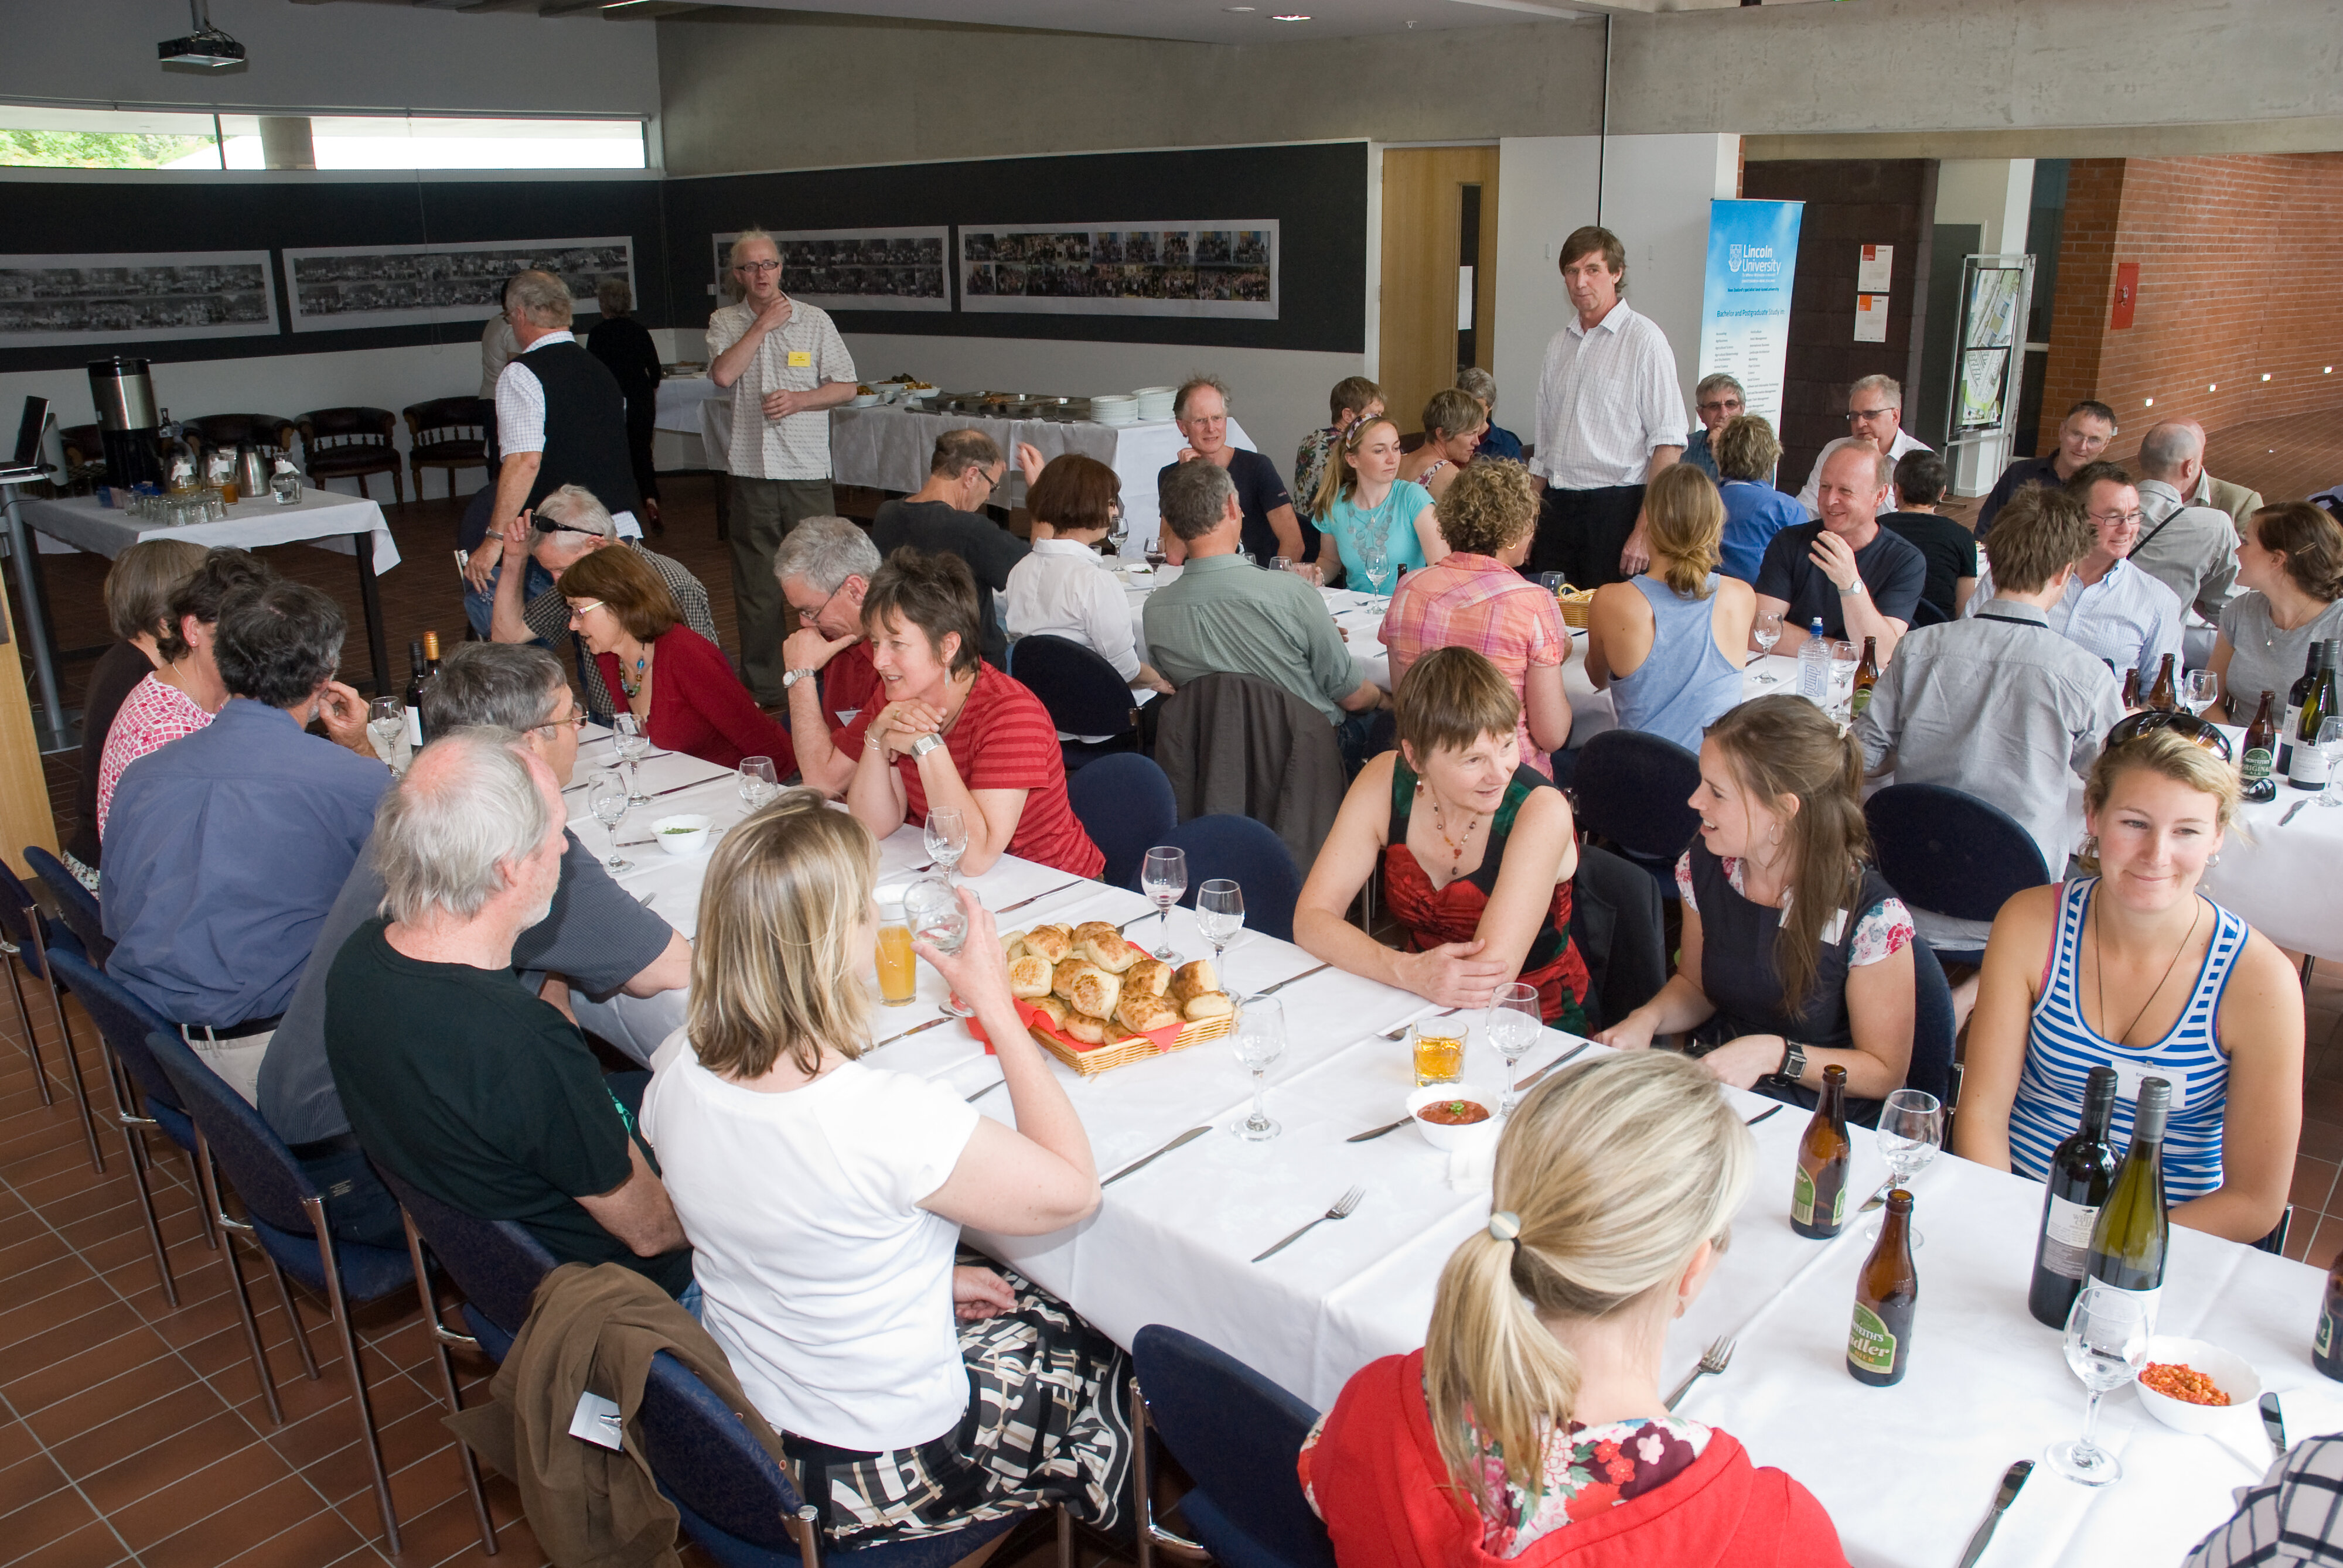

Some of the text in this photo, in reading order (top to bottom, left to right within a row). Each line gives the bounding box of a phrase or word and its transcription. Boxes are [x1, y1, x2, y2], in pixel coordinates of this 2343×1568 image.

[1743, 244, 1772, 258] Lincoln
[1742, 258, 1782, 275] University
[1742, 309, 1768, 317] Postgraduate
[1768, 308, 1779, 316] Study
[1804, 665, 1820, 698] pump
